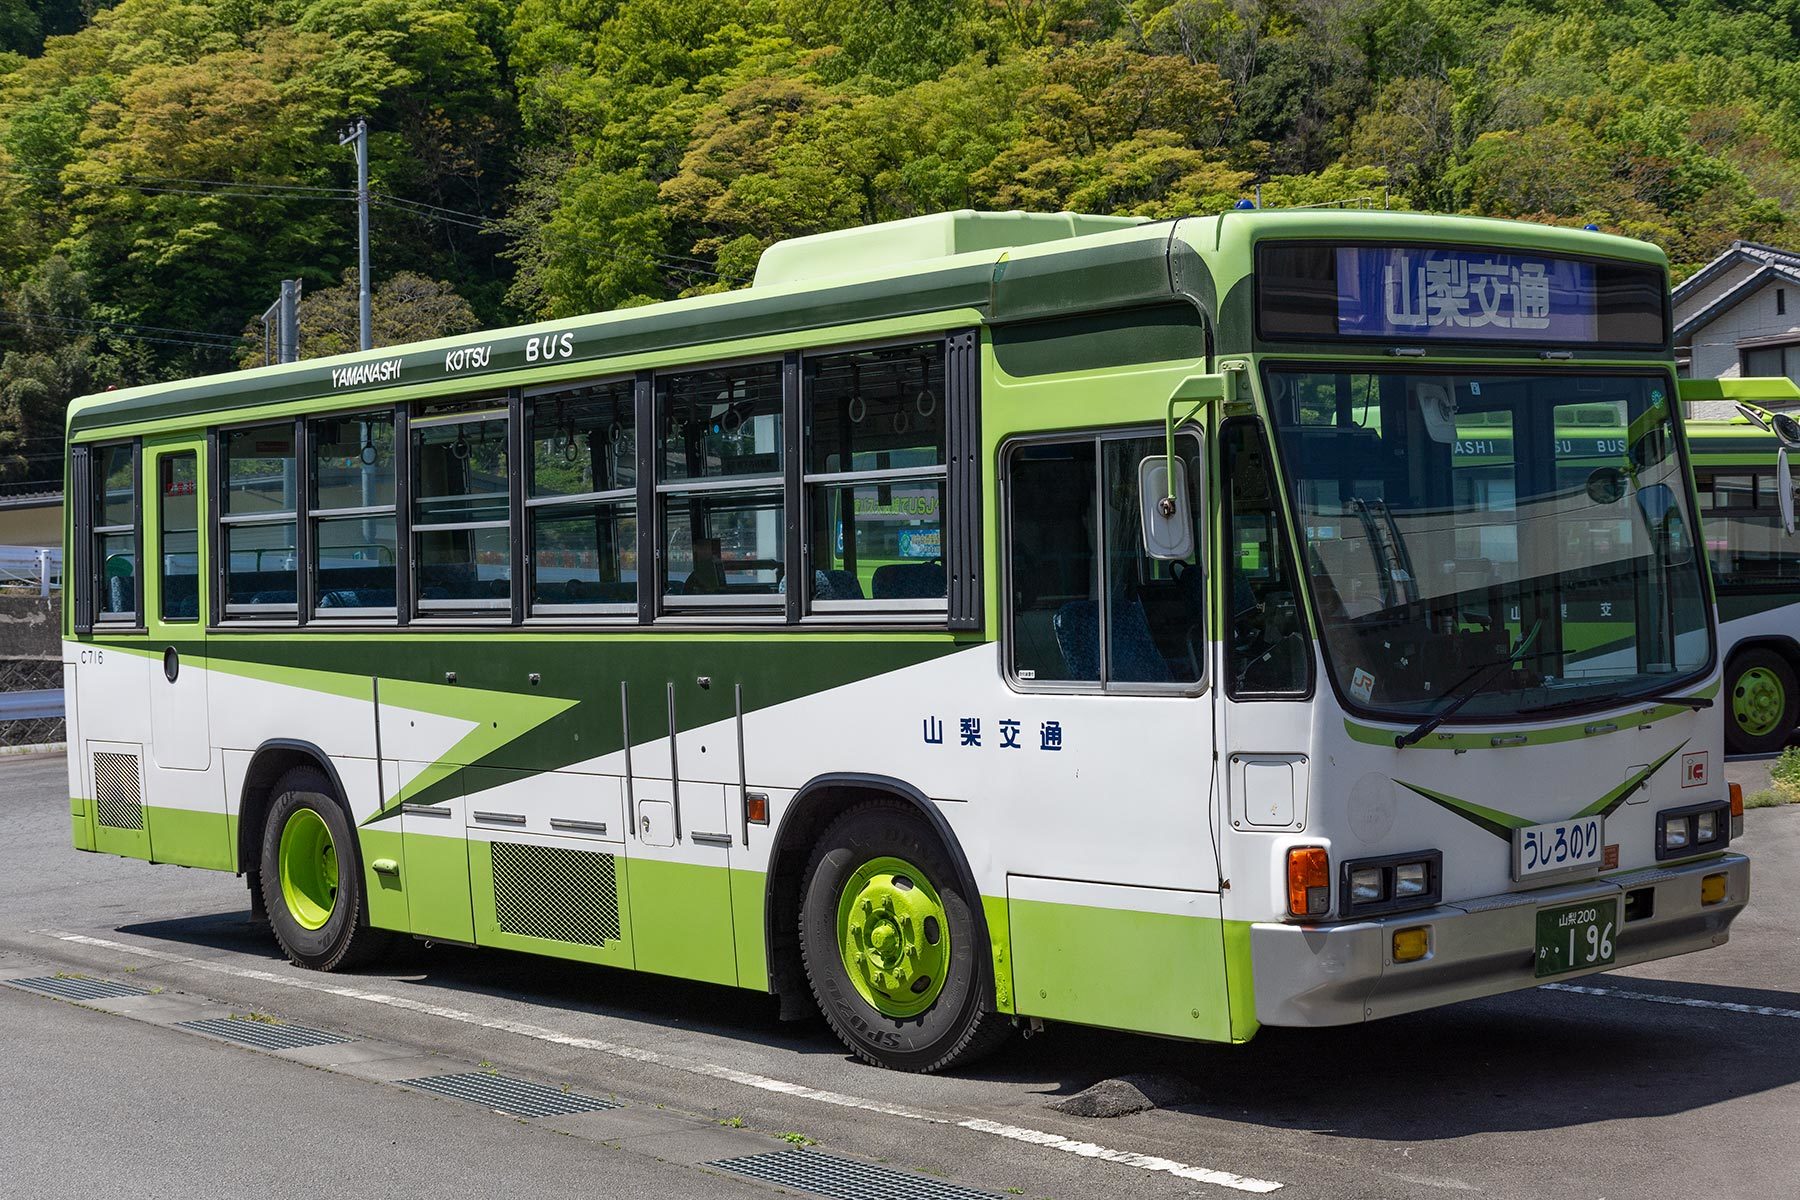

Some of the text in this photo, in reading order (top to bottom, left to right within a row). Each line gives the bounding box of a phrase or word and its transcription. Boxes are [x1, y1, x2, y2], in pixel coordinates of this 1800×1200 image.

[1384, 256, 1551, 330] 山梨交通
[331, 331, 574, 389] YAMANASHI KOTSU BUS
[1597, 439, 1626, 453] BUS
[80, 649, 104, 666] C716
[1353, 674, 1373, 693] JR
[923, 715, 1063, 751] 山梨交通
[1524, 820, 1598, 870] うしろのり
[1539, 946, 1550, 959] か
